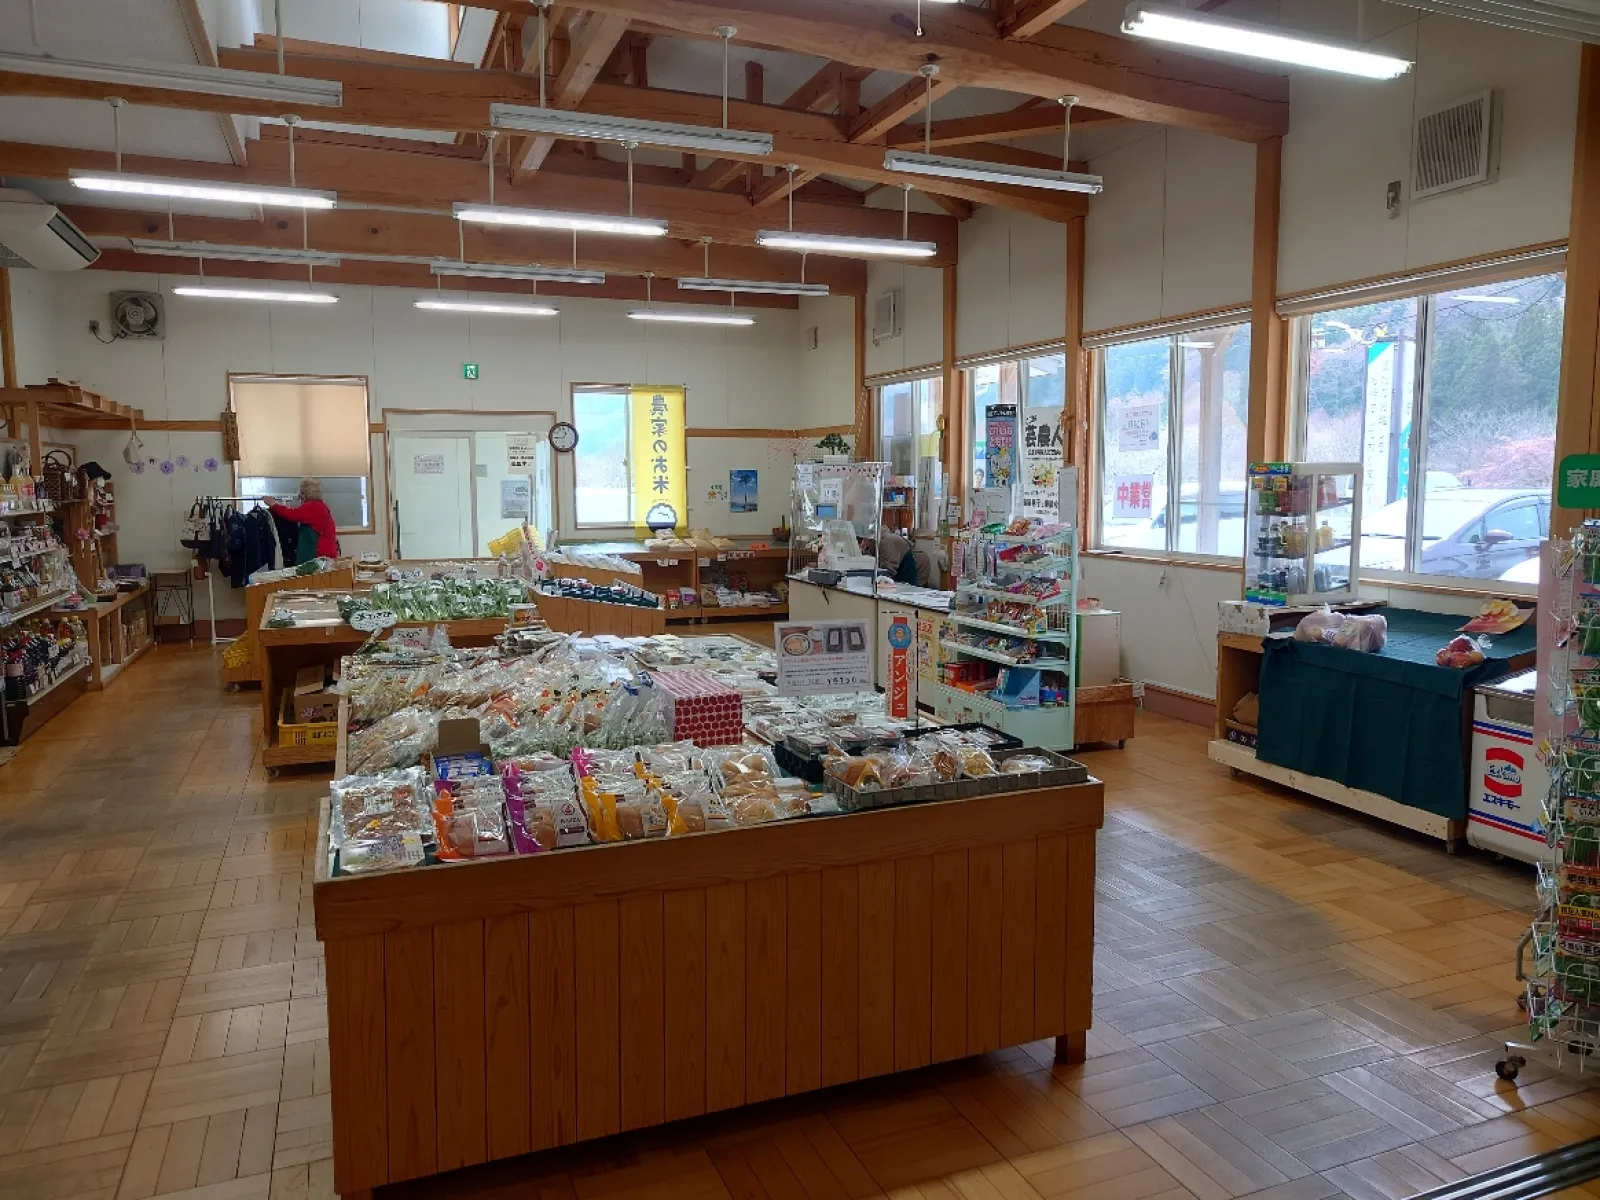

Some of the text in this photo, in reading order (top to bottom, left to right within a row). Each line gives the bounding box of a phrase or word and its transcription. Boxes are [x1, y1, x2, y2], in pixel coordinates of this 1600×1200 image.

[1482, 792, 1521, 811] エスキモー
